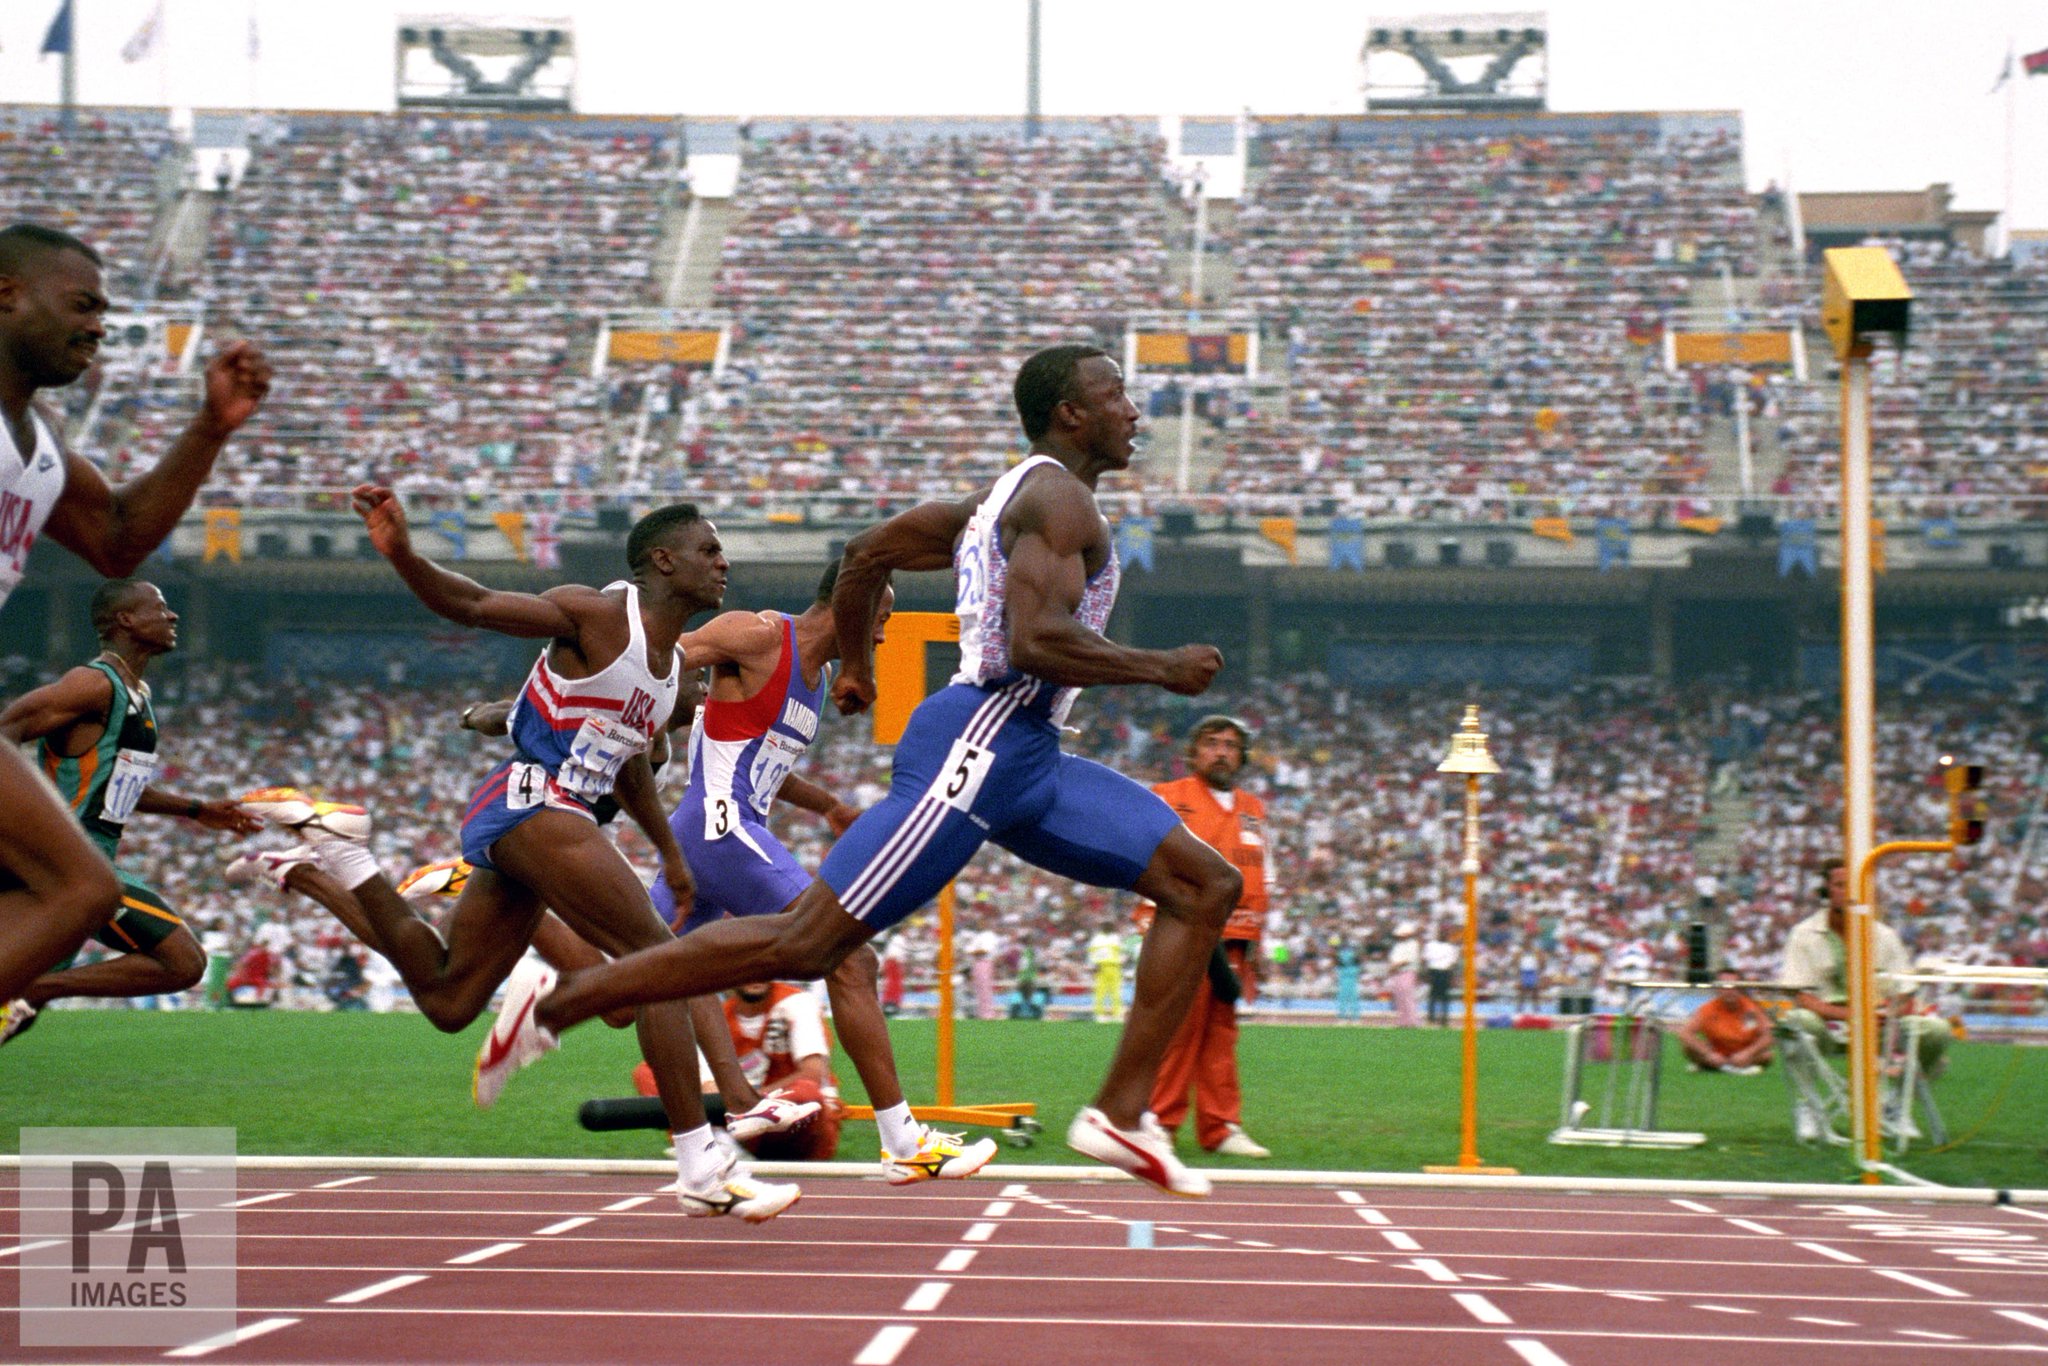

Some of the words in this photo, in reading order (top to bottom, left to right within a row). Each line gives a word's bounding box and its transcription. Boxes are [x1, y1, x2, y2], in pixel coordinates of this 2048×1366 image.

[621, 687, 656, 738] USA
[519, 766, 532, 804] 4
[946, 749, 979, 799] 5
[715, 799, 728, 835] 3
